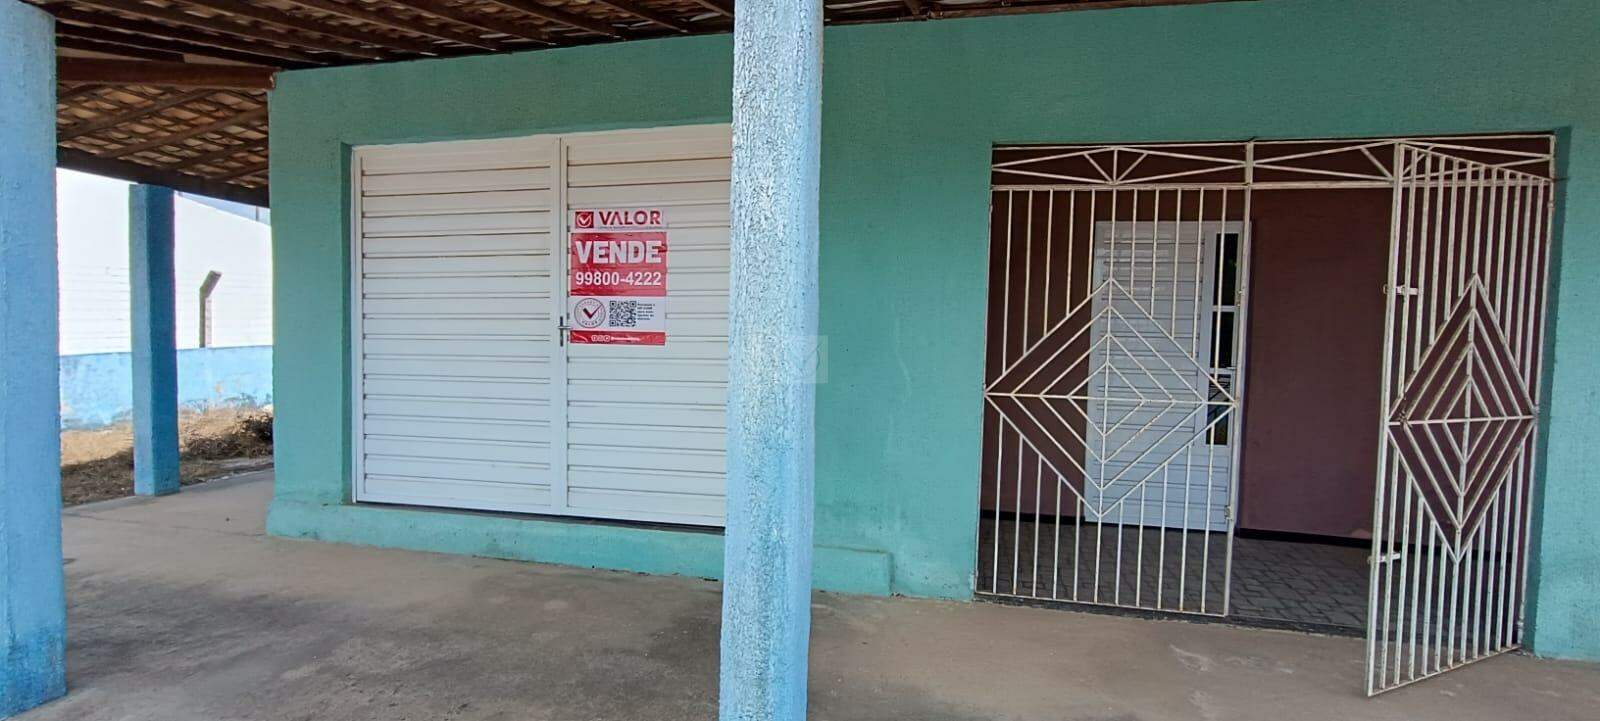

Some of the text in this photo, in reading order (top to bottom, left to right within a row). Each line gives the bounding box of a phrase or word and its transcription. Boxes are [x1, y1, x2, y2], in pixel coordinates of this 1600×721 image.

[599, 211, 661, 225] VALOR
[575, 240, 662, 264] VENDE
[575, 271, 662, 286] 99800-4222
